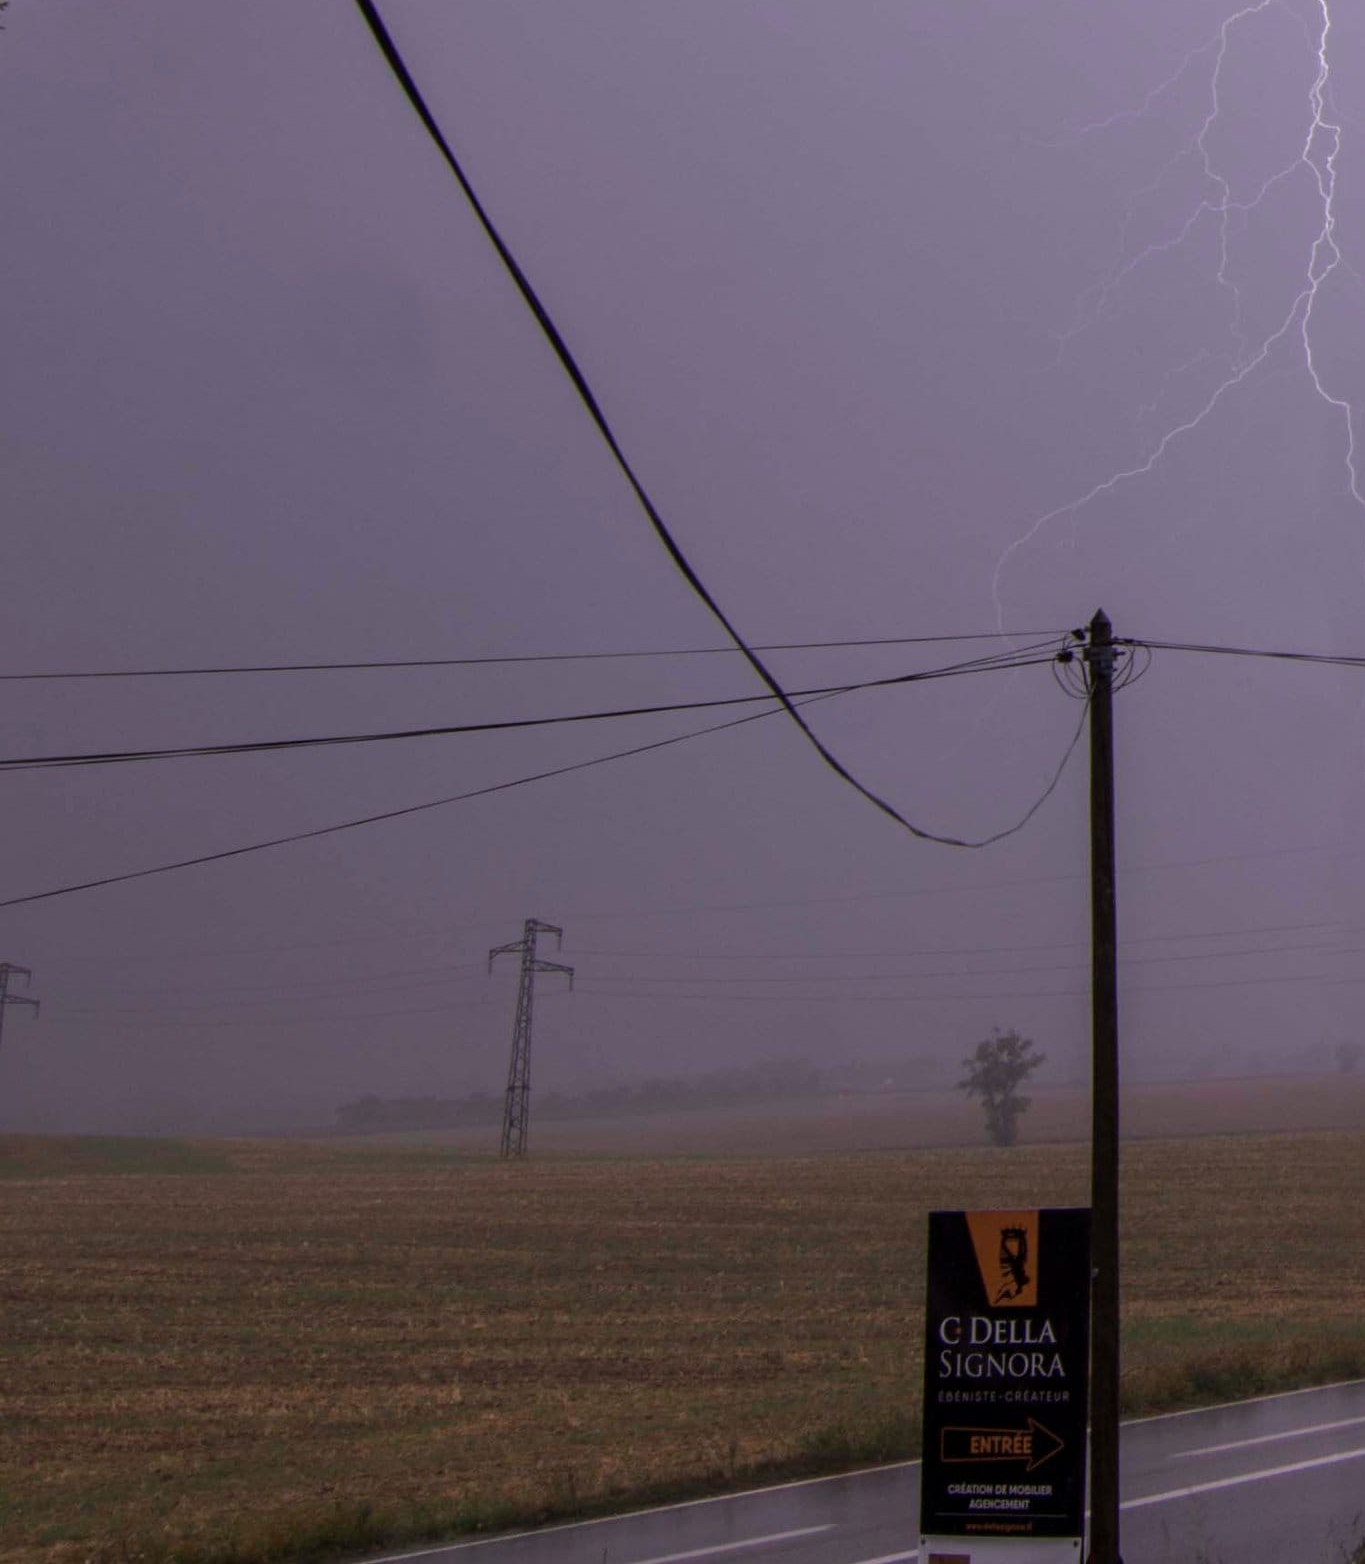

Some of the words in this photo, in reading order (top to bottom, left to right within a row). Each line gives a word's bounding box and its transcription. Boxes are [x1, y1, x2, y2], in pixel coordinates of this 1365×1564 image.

[969, 1316, 1057, 1345] DELLA
[939, 1350, 1066, 1379] SIGNORA
[970, 1431, 1033, 1454] ENTRÉE
[947, 1481, 993, 1495] CRÉATION
[994, 1483, 1008, 1495] DE
[1009, 1483, 1053, 1496] MOBILIER
[969, 1498, 1031, 1510] AGENCEMENT
